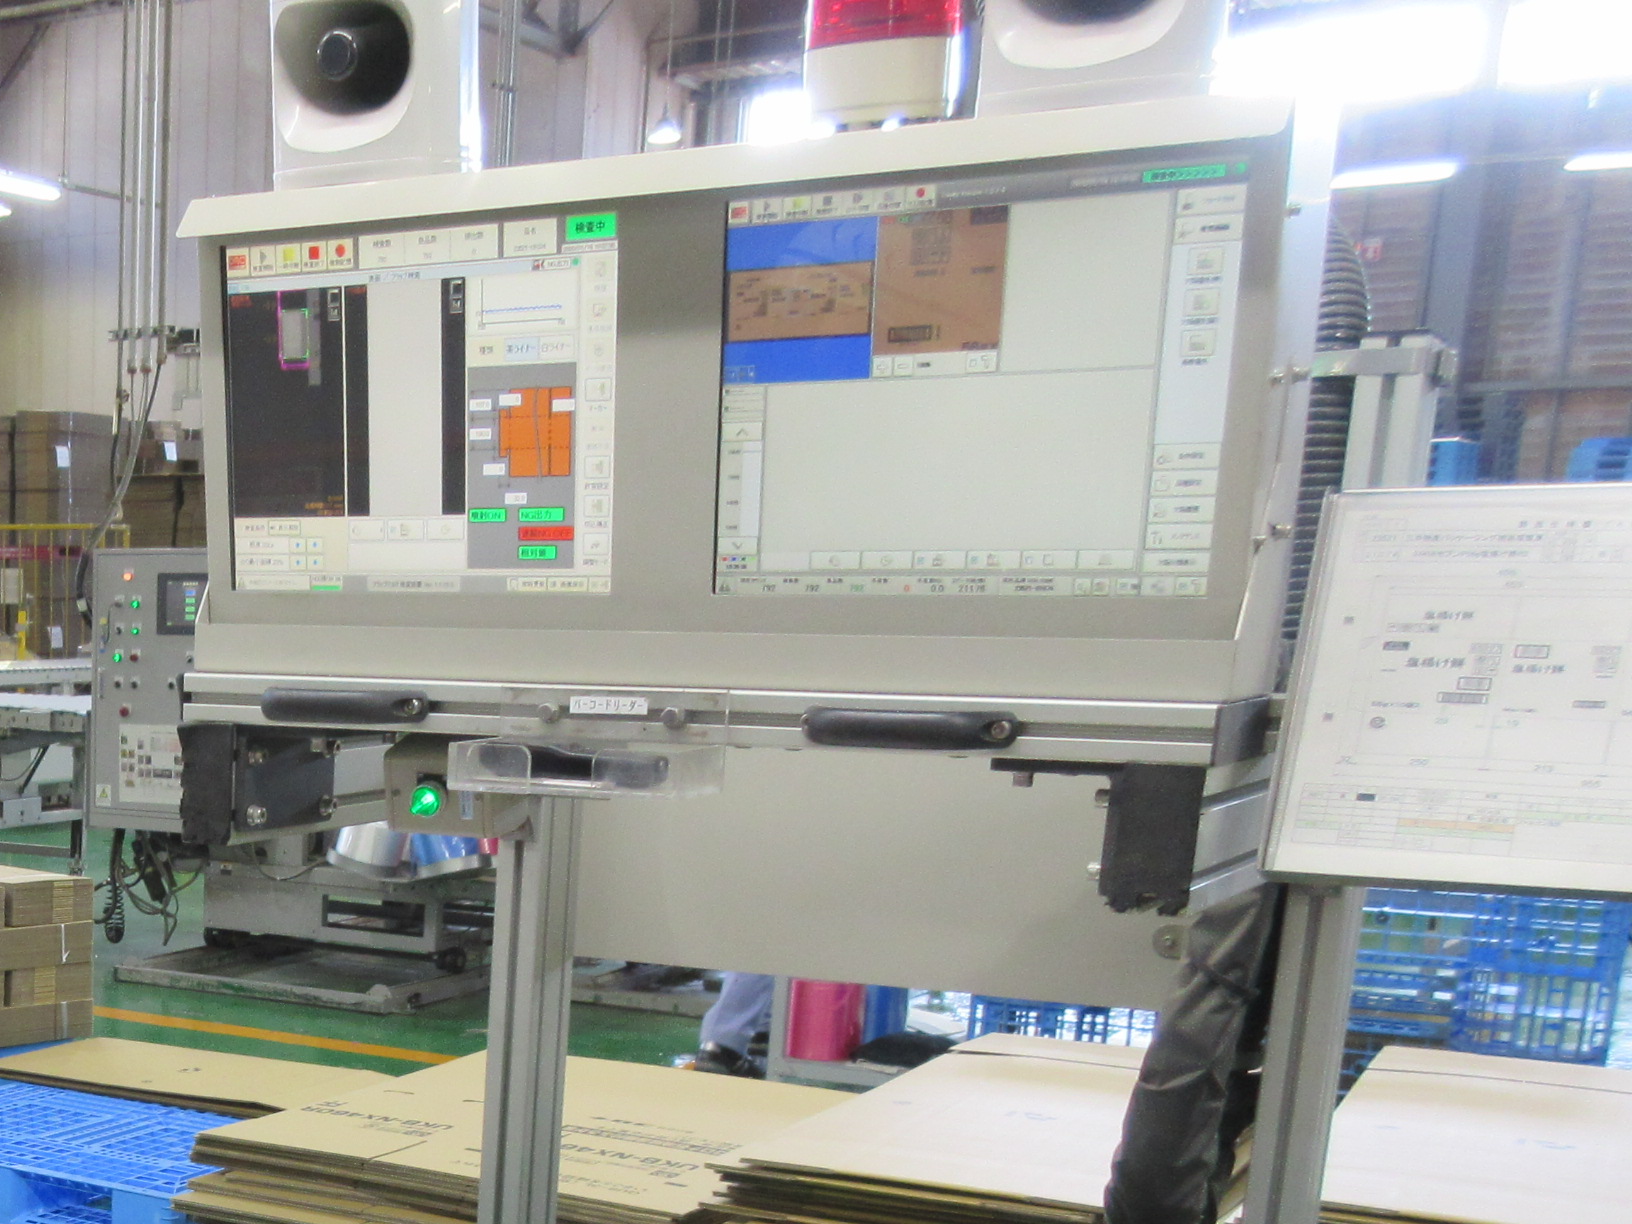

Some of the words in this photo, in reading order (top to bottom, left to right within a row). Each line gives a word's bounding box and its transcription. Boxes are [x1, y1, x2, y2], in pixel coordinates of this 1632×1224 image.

[575, 220, 606, 234] 検査中
[520, 510, 552, 520] NG出力
[573, 699, 644, 711] バーコードリーダー
[561, 1143, 700, 1171] UKB-NX46
